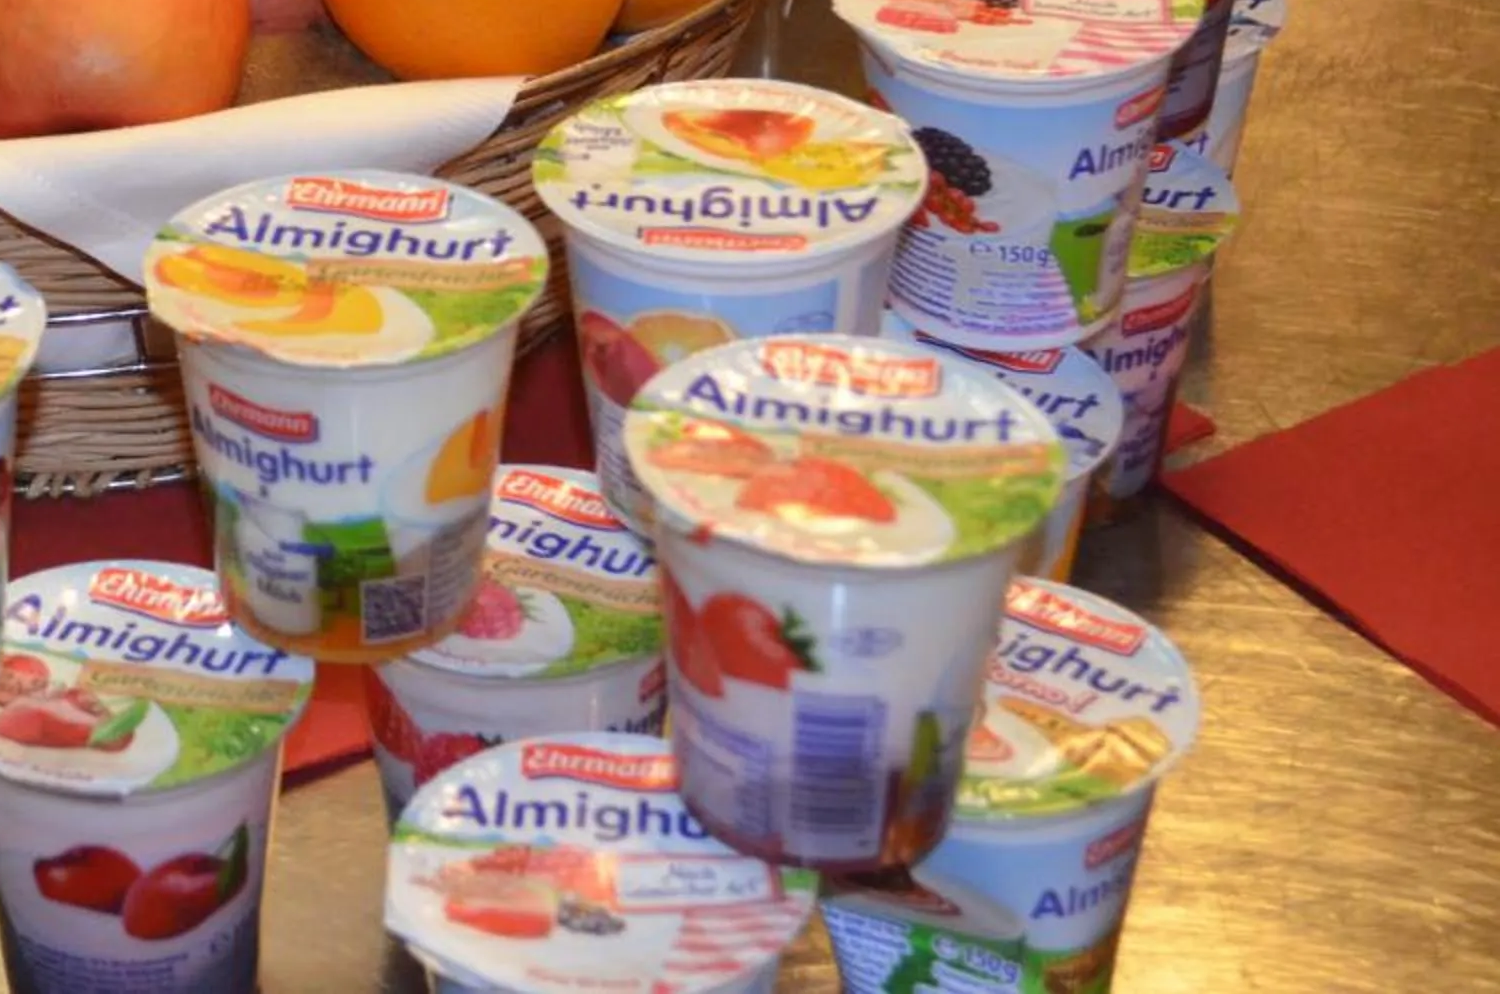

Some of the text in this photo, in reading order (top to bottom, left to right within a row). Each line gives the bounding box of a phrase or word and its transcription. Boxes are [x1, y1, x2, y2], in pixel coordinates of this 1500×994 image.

[293, 180, 440, 214] Ehrmann
[569, 186, 879, 228] Almighurt
[203, 205, 514, 262] Almighurt
[684, 372, 1018, 443] Almighurt
[4, 593, 290, 676] Almighurt
[998, 632, 1180, 712] ighurt
